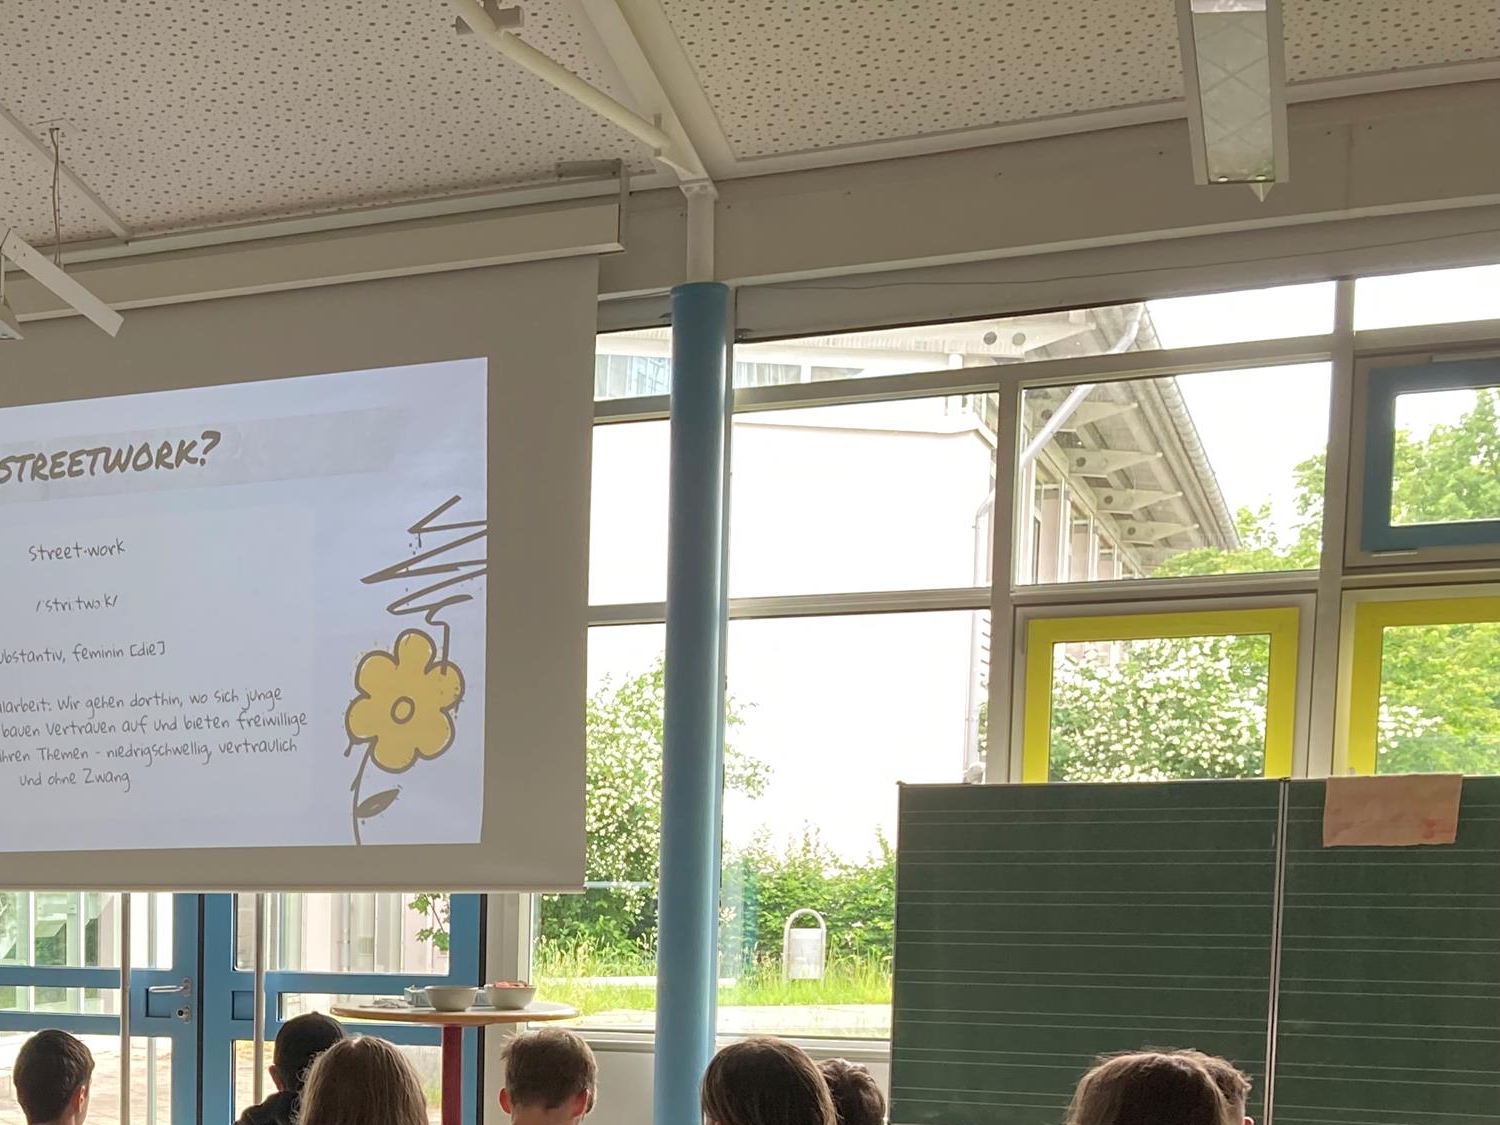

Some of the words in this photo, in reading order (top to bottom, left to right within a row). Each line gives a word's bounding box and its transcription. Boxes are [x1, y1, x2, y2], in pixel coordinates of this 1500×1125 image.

[72, 643, 124, 662] feminin
[57, 695, 80, 711] Wir
[85, 695, 124, 719] gehen
[130, 692, 183, 707] dorthin,
[189, 693, 208, 704] wo
[241, 687, 282, 711] junge
[1, 723, 40, 738] bauen
[45, 721, 116, 736] Vertrauen
[121, 714, 148, 734] auf
[153, 715, 177, 731] und
[184, 714, 230, 731] bieten
[236, 710, 308, 736] freiwillige
[0, 750, 30, 763] ihren
[36, 747, 88, 761] Themen
[218, 738, 297, 754] vertraulich
[19, 771, 42, 786] und
[47, 771, 76, 785] ohne
[83, 768, 131, 793] Zwang
